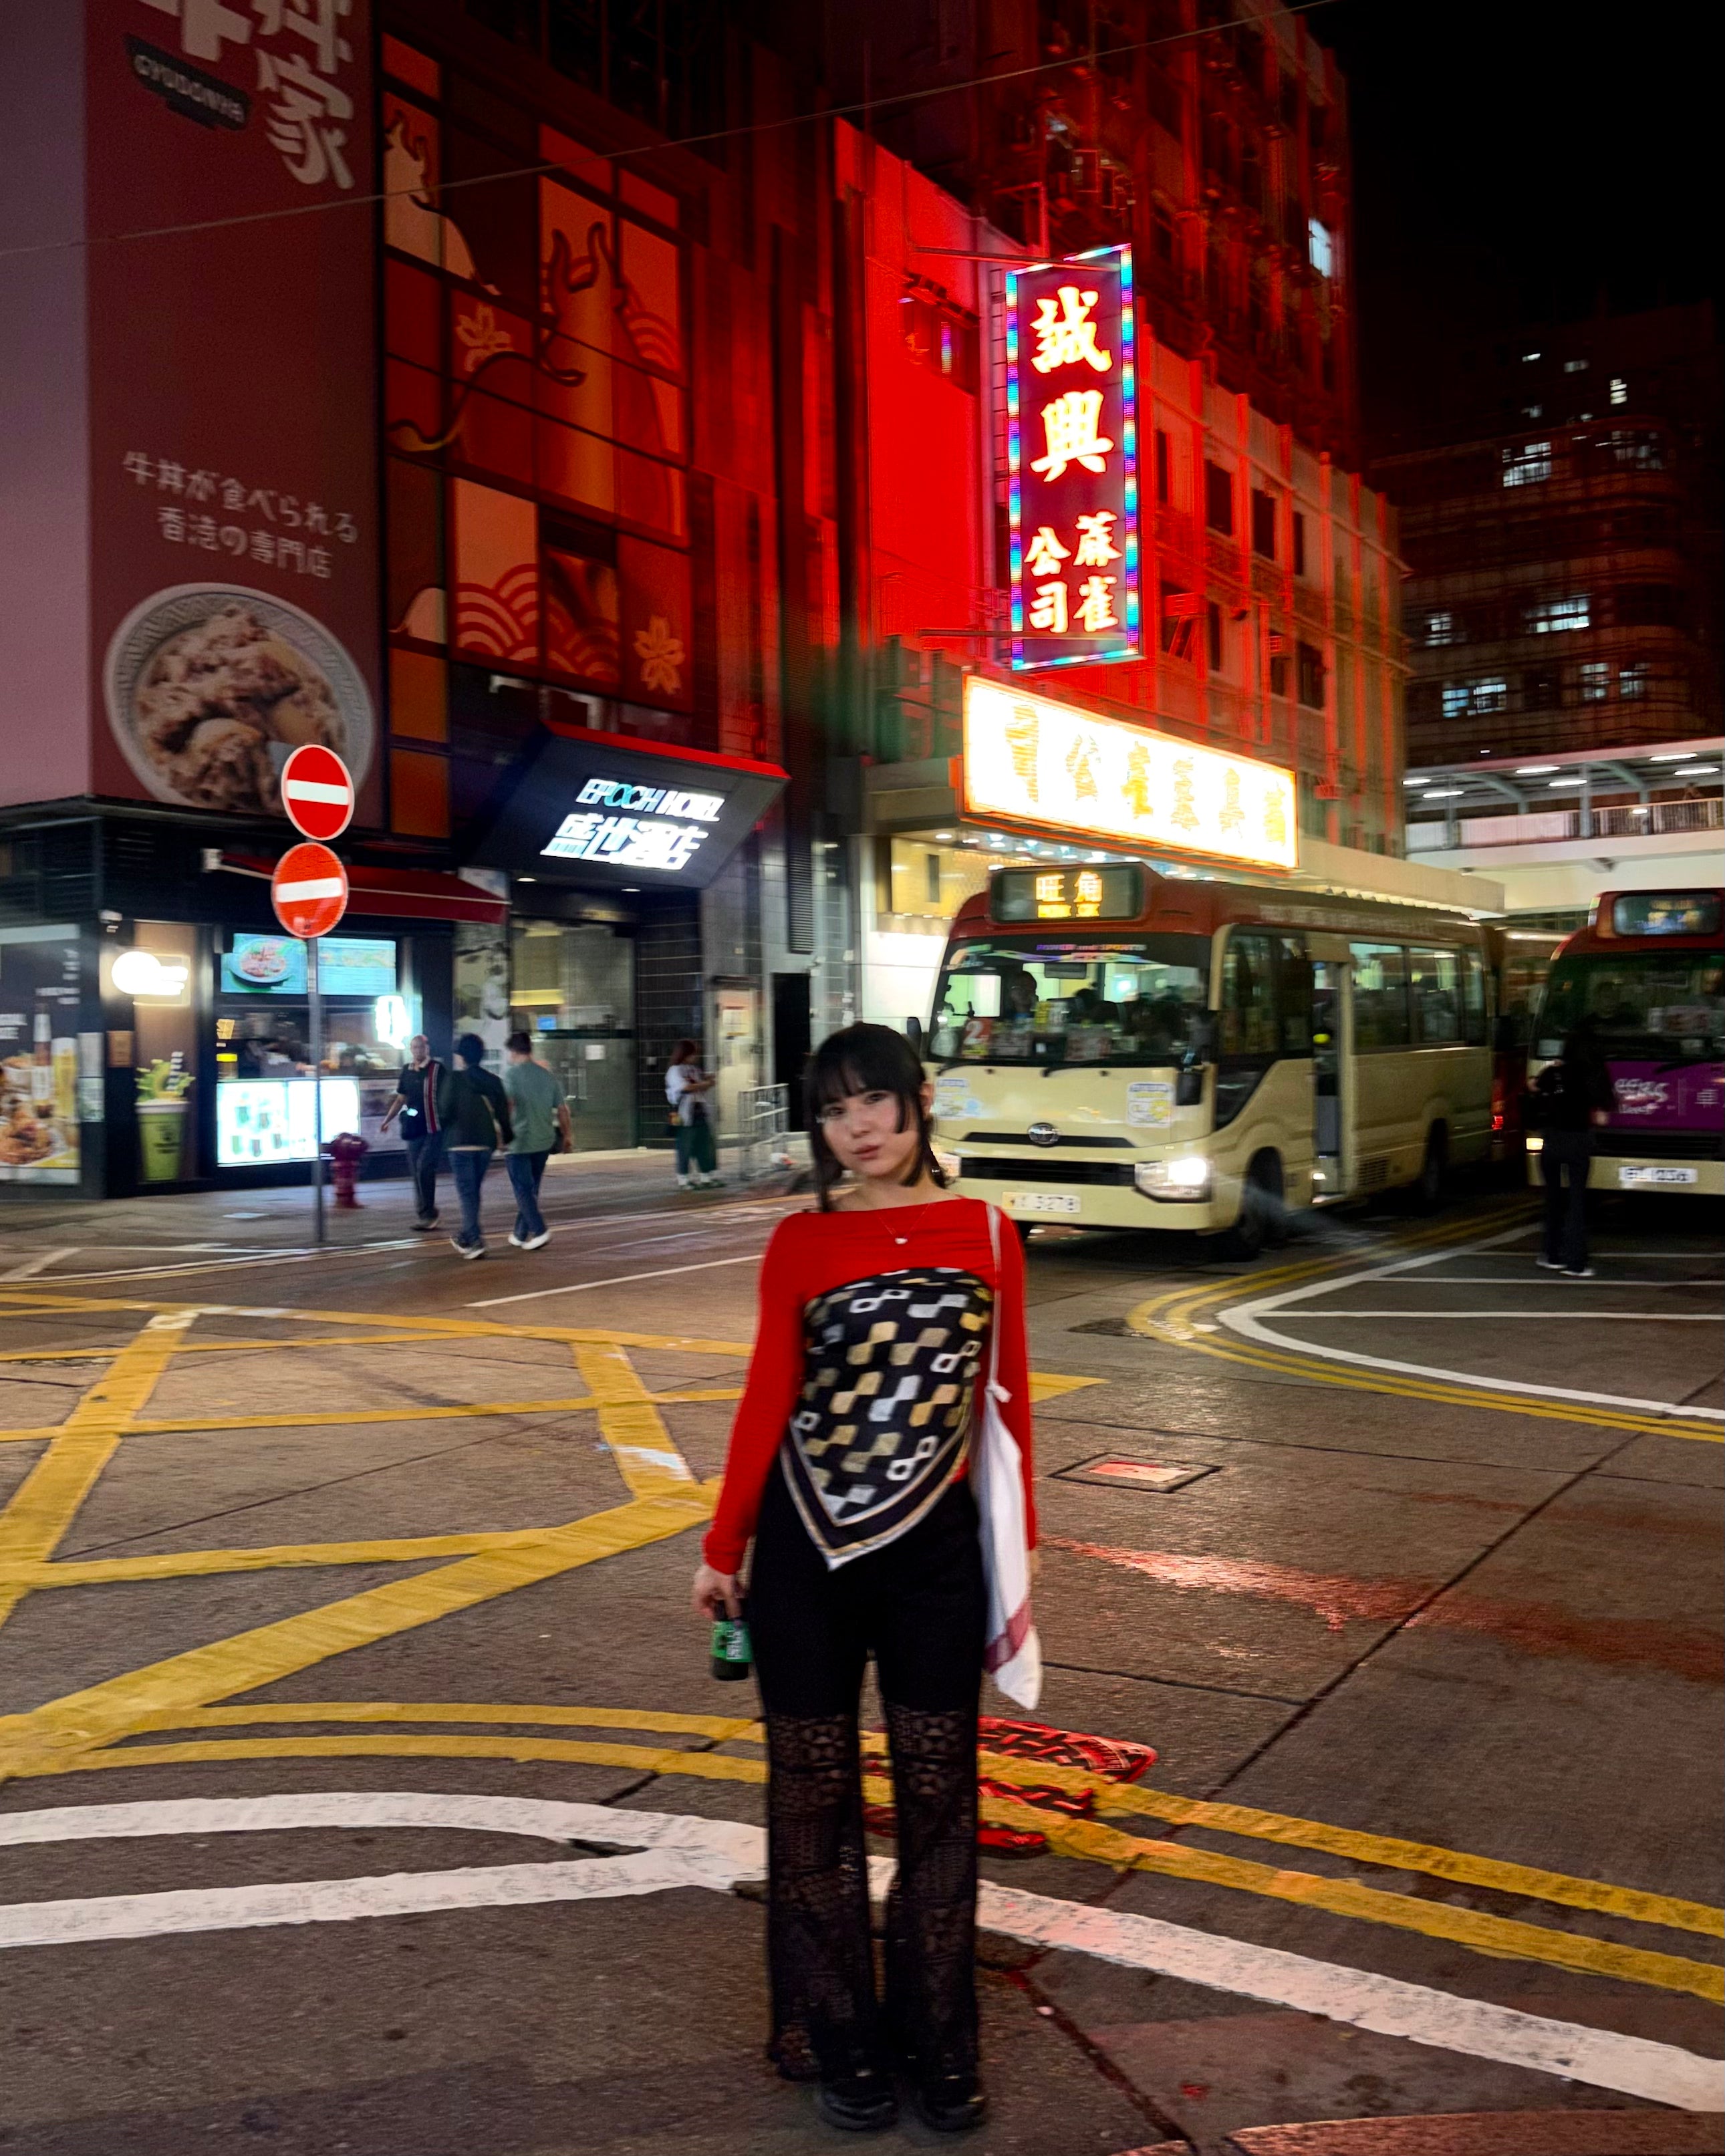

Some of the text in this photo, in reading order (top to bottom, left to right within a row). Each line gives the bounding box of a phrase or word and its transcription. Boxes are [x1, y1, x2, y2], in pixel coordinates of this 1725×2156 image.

[1024, 526, 1071, 633] 公司
[575, 778, 667, 815] EPOCH
[539, 812, 709, 870] 盛世酒店
[1035, 871, 1103, 904] 旺角
